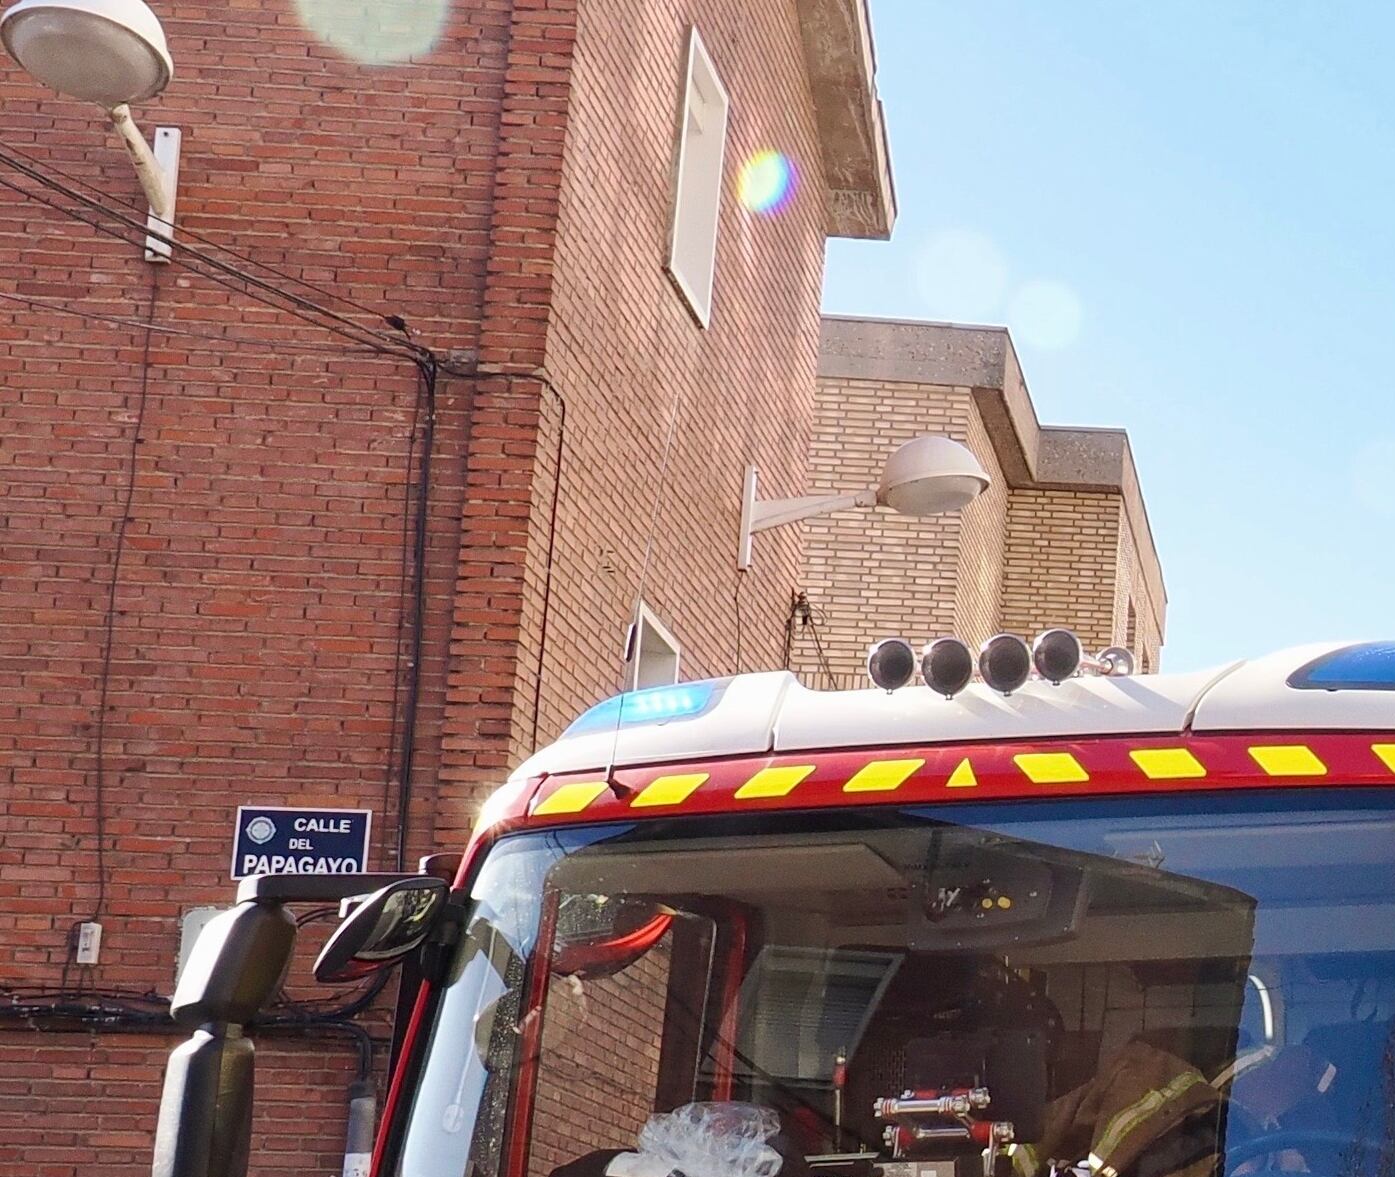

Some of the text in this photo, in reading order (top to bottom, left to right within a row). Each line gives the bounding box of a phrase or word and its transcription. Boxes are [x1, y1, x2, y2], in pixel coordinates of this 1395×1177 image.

[294, 818, 352, 833] CALLE
[288, 838, 314, 850] DEL
[243, 854, 358, 875] PAPAGAYO
